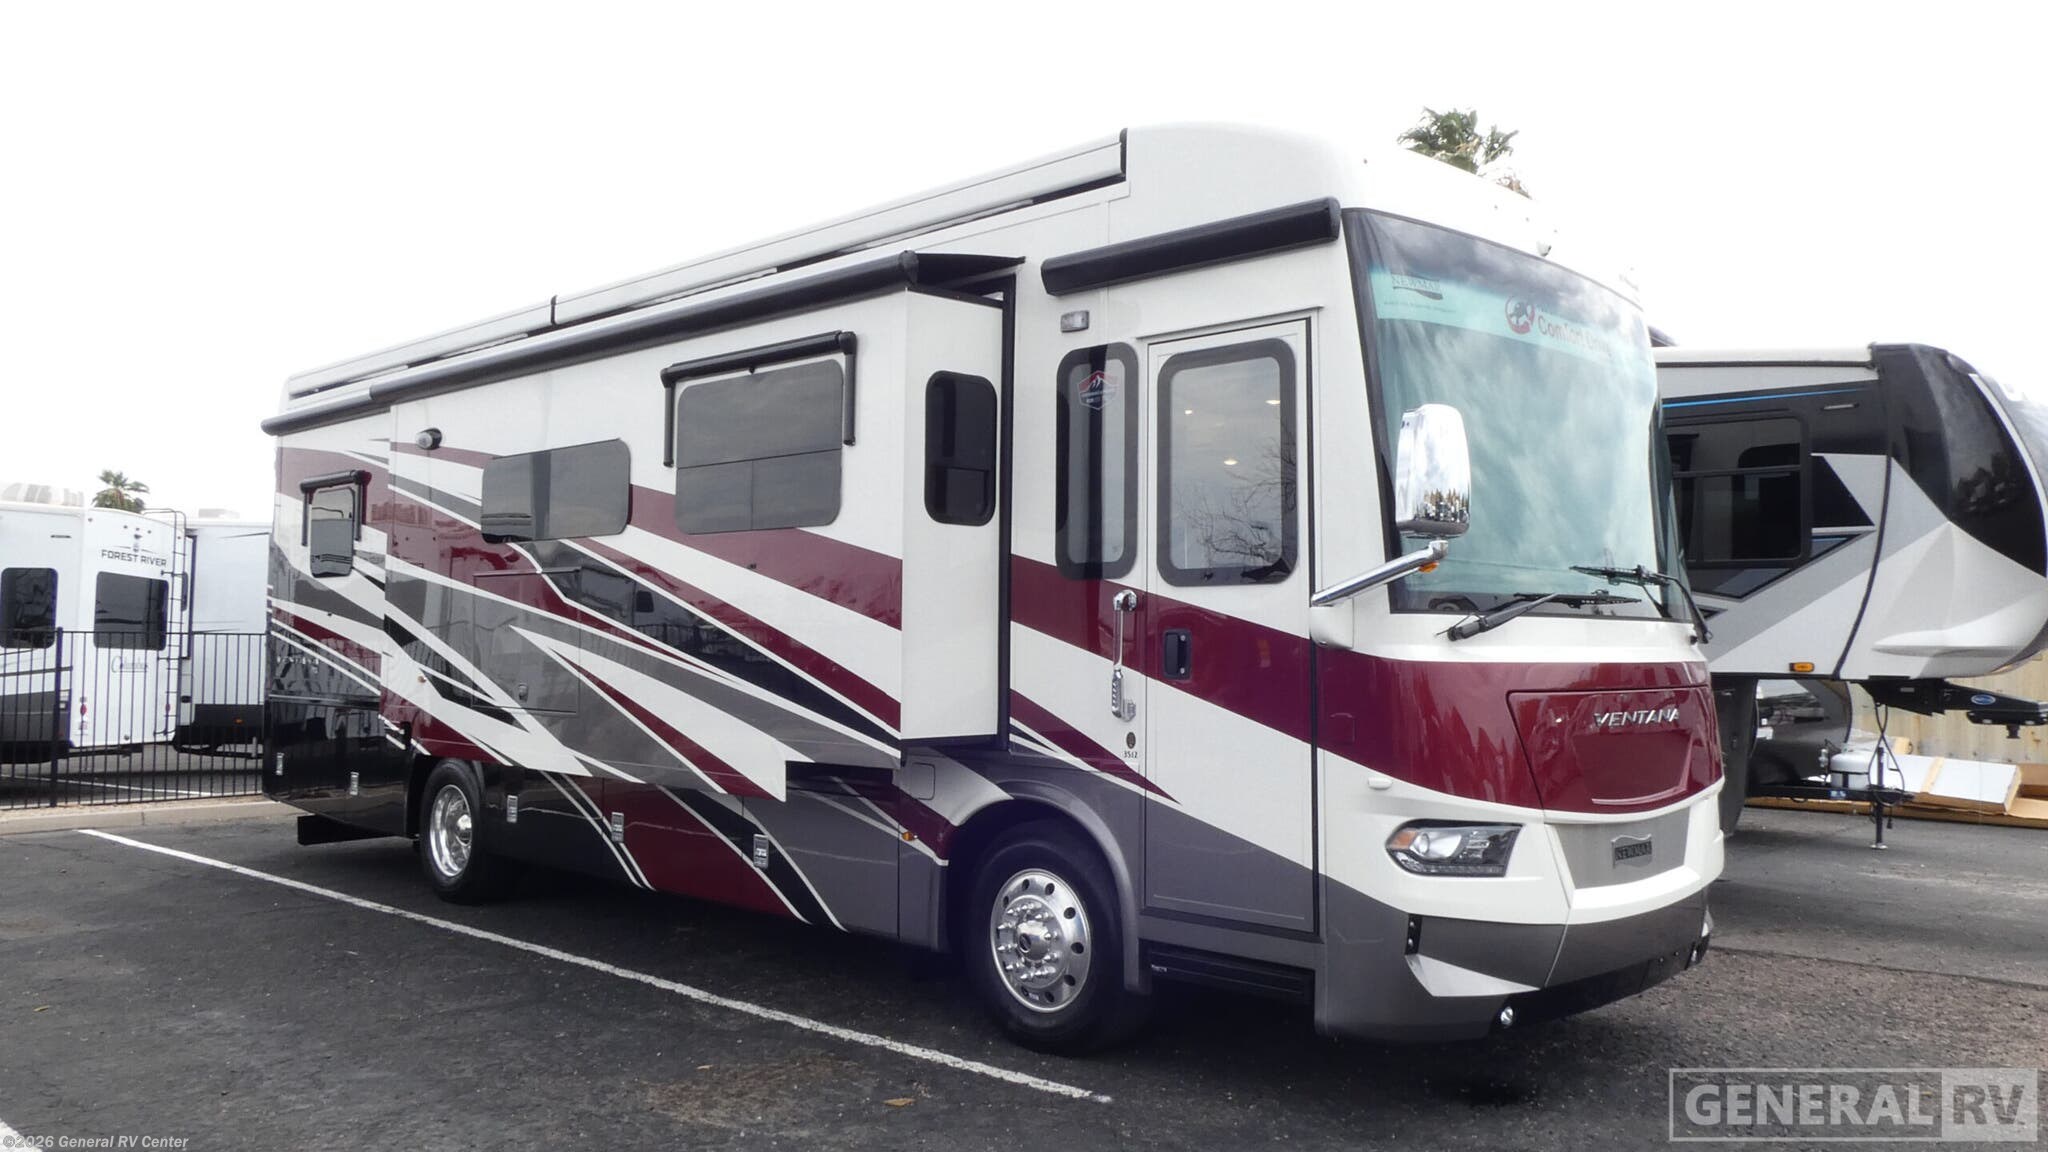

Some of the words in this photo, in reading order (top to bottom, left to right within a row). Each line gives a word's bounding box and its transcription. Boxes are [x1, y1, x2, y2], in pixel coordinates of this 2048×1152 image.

[101, 549, 139, 562] FOREST
[140, 555, 167, 567] RIVER
[1594, 708, 1679, 727] VENTANA
